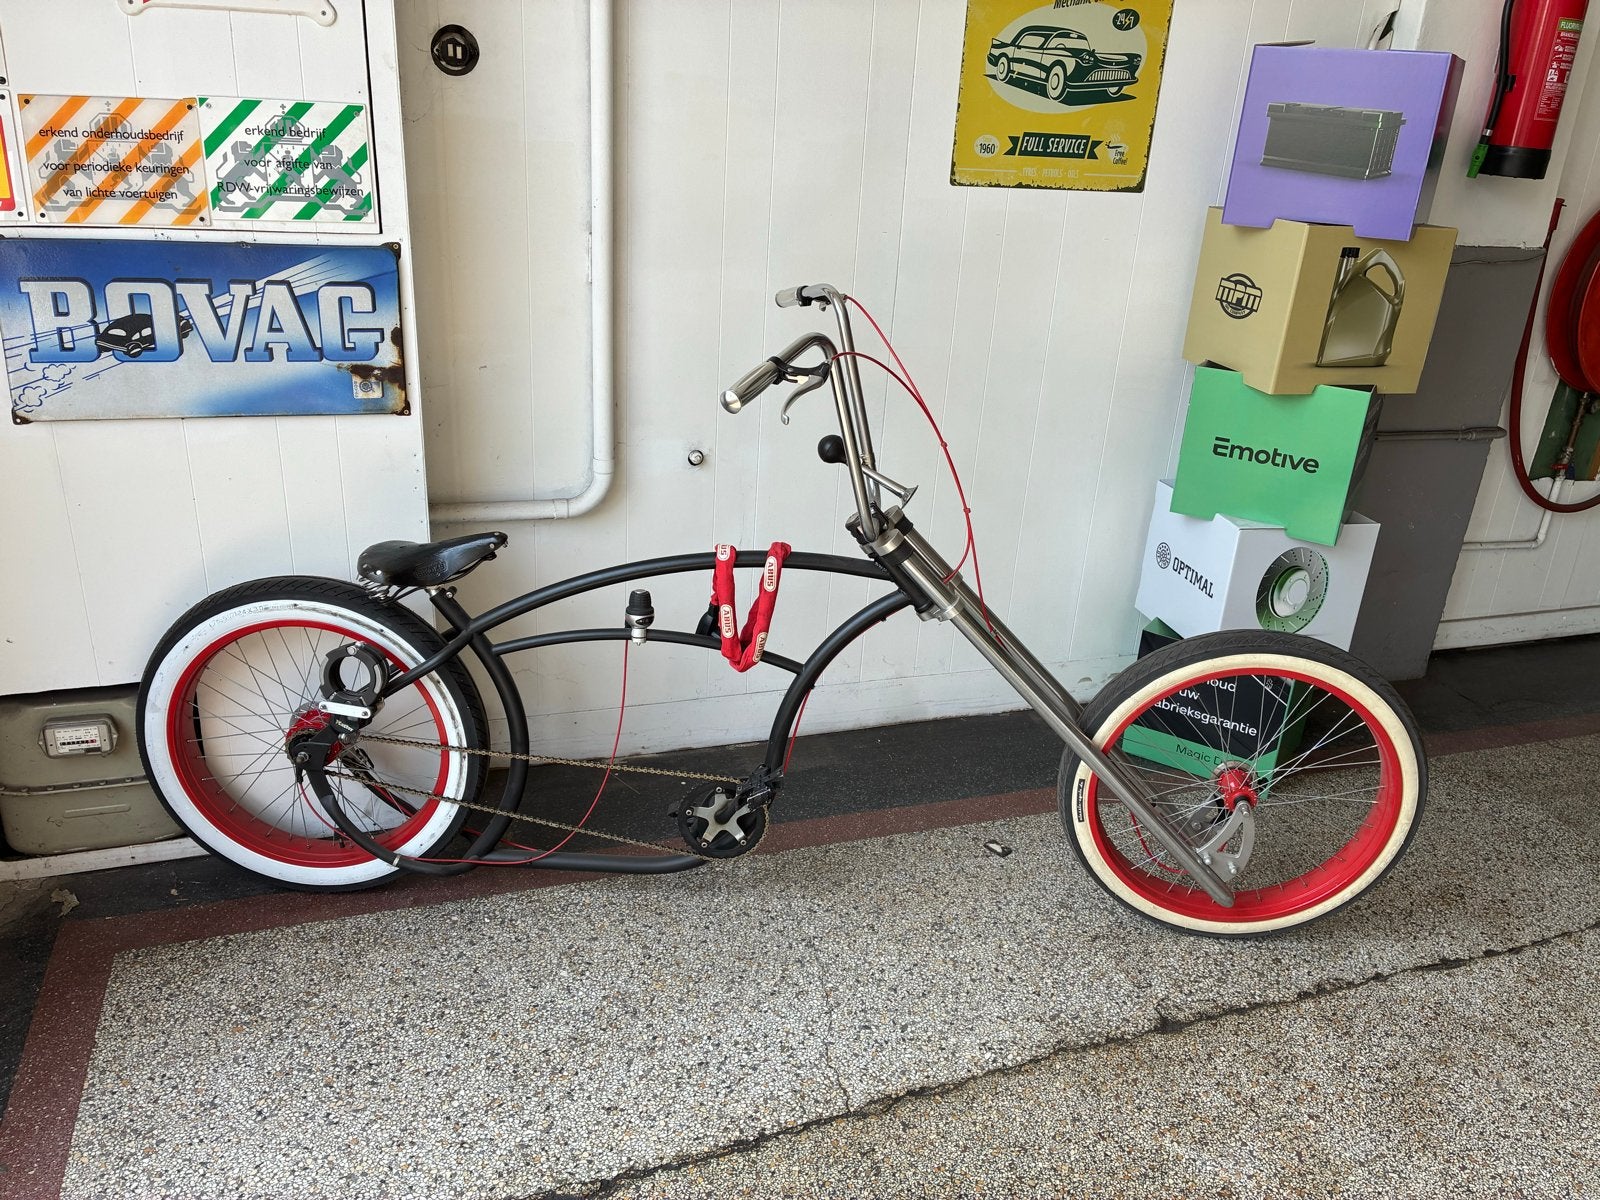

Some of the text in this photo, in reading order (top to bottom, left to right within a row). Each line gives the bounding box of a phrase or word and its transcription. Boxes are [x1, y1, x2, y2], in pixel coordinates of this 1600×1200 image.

[38, 127, 184, 143] erkend onderhoudsbedrijf
[244, 125, 326, 141] erkend bedrijf
[979, 142, 996, 155] 1960
[1021, 136, 1086, 154] FULL SERVICE
[43, 161, 190, 176] voor periodieke keuringen
[244, 158, 333, 171] voor afgifte van
[62, 186, 178, 202] van lichte voertuigen
[216, 181, 364, 197] RDW-vrijwaringsbewijzen
[18, 277, 385, 364] BOVAG
[1212, 436, 1320, 474] Emotive
[766, 561, 775, 588] ABUS
[1172, 556, 1214, 599] OPTIMAL
[723, 609, 732, 634] ABUS
[1179, 689, 1200, 700] uw
[1154, 698, 1258, 737] abrieksgarantie
[1175, 743, 1211, 762] Magic
